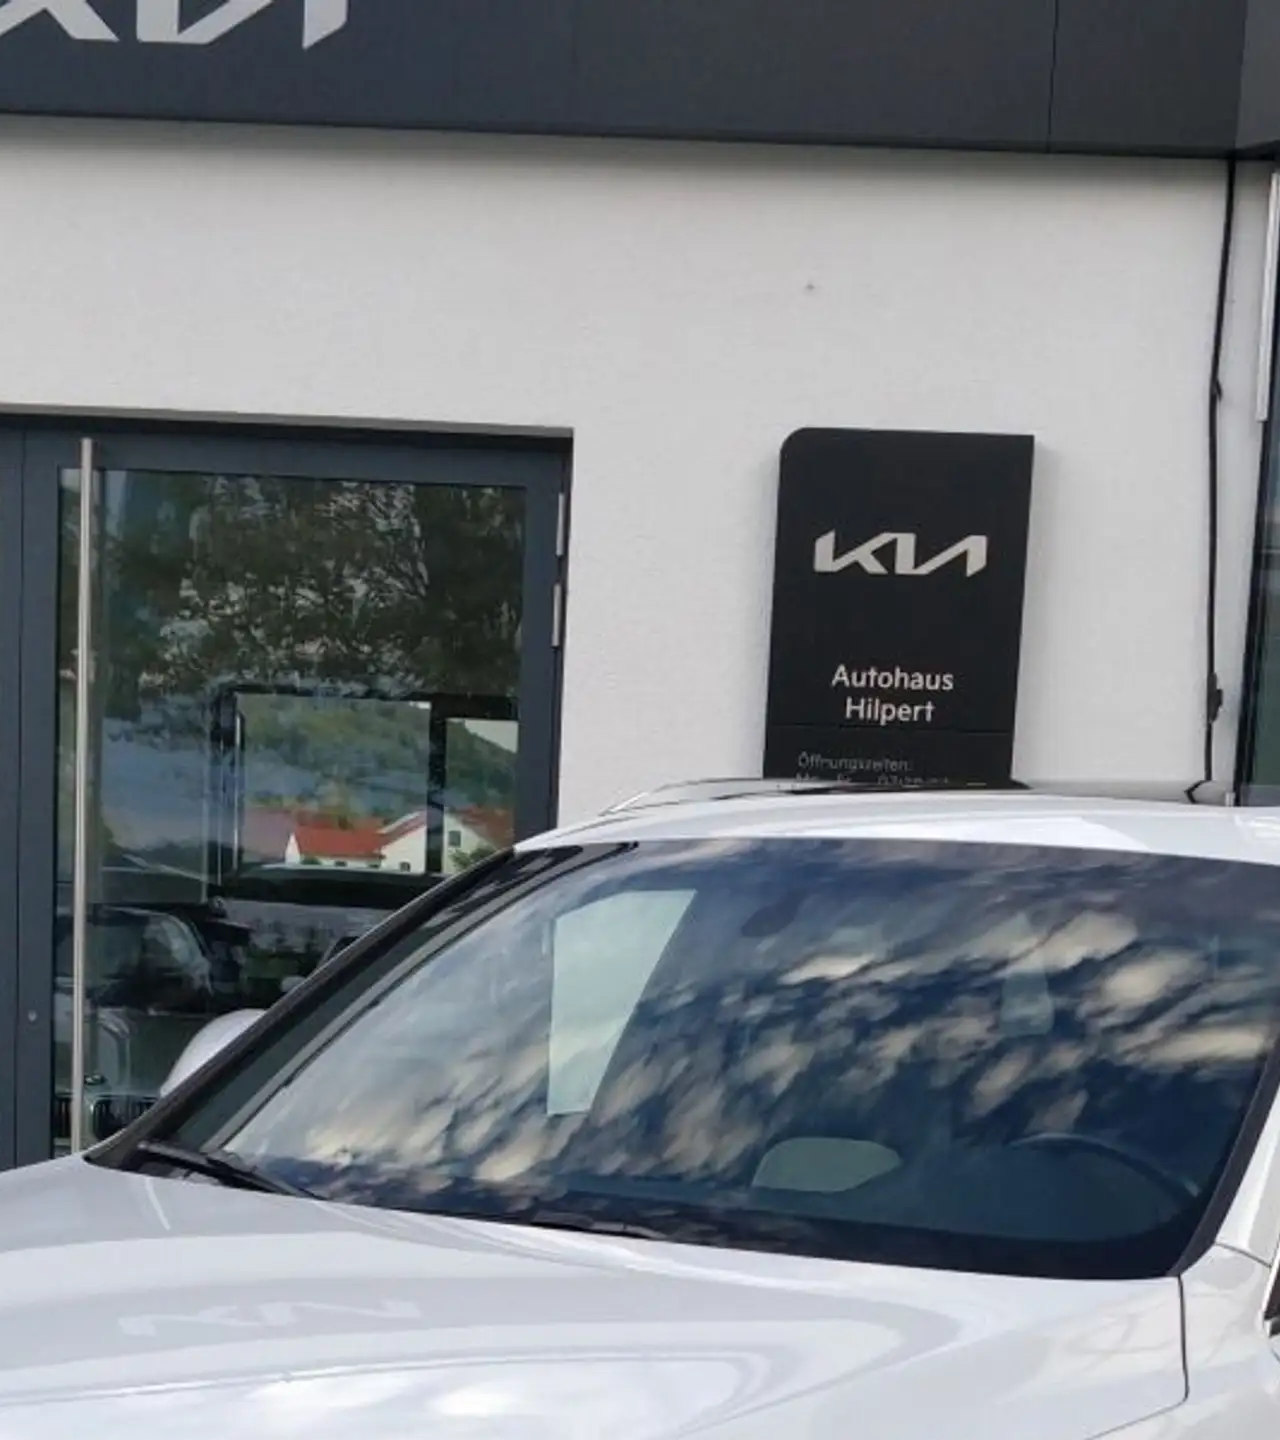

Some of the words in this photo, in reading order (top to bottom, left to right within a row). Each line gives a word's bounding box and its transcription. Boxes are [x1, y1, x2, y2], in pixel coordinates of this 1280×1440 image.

[813, 529, 988, 577] KIA
[831, 664, 954, 690] Autohaus
[845, 697, 936, 726] Hilpert
